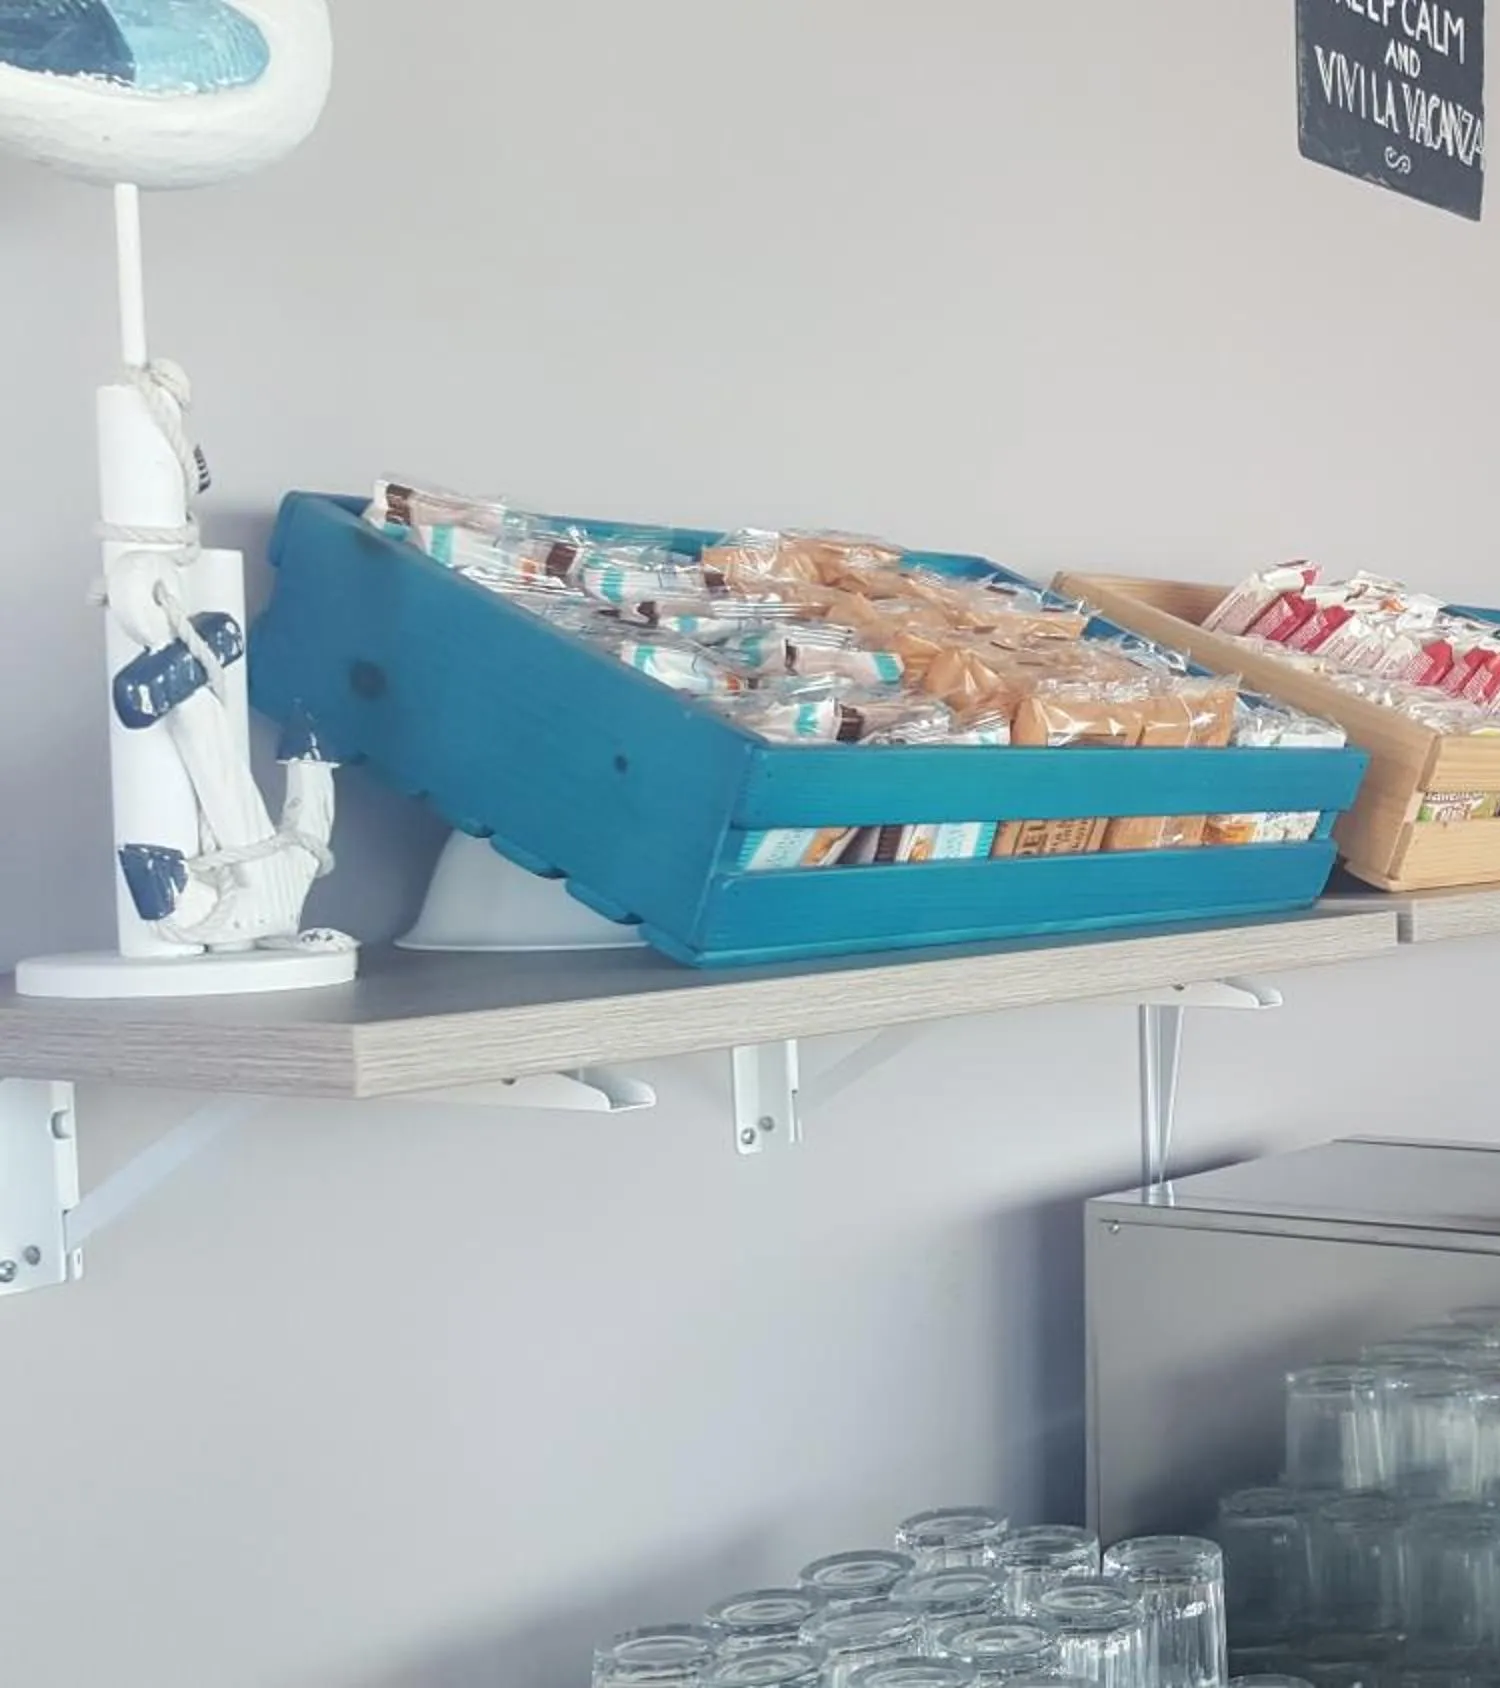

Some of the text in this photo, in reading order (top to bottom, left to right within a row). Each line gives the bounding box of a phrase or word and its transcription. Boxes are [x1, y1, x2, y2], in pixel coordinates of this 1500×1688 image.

[1384, 38, 1421, 79] AND
[1401, 0, 1465, 64] CALM
[1313, 44, 1485, 168] VIVI LA VACANZA
